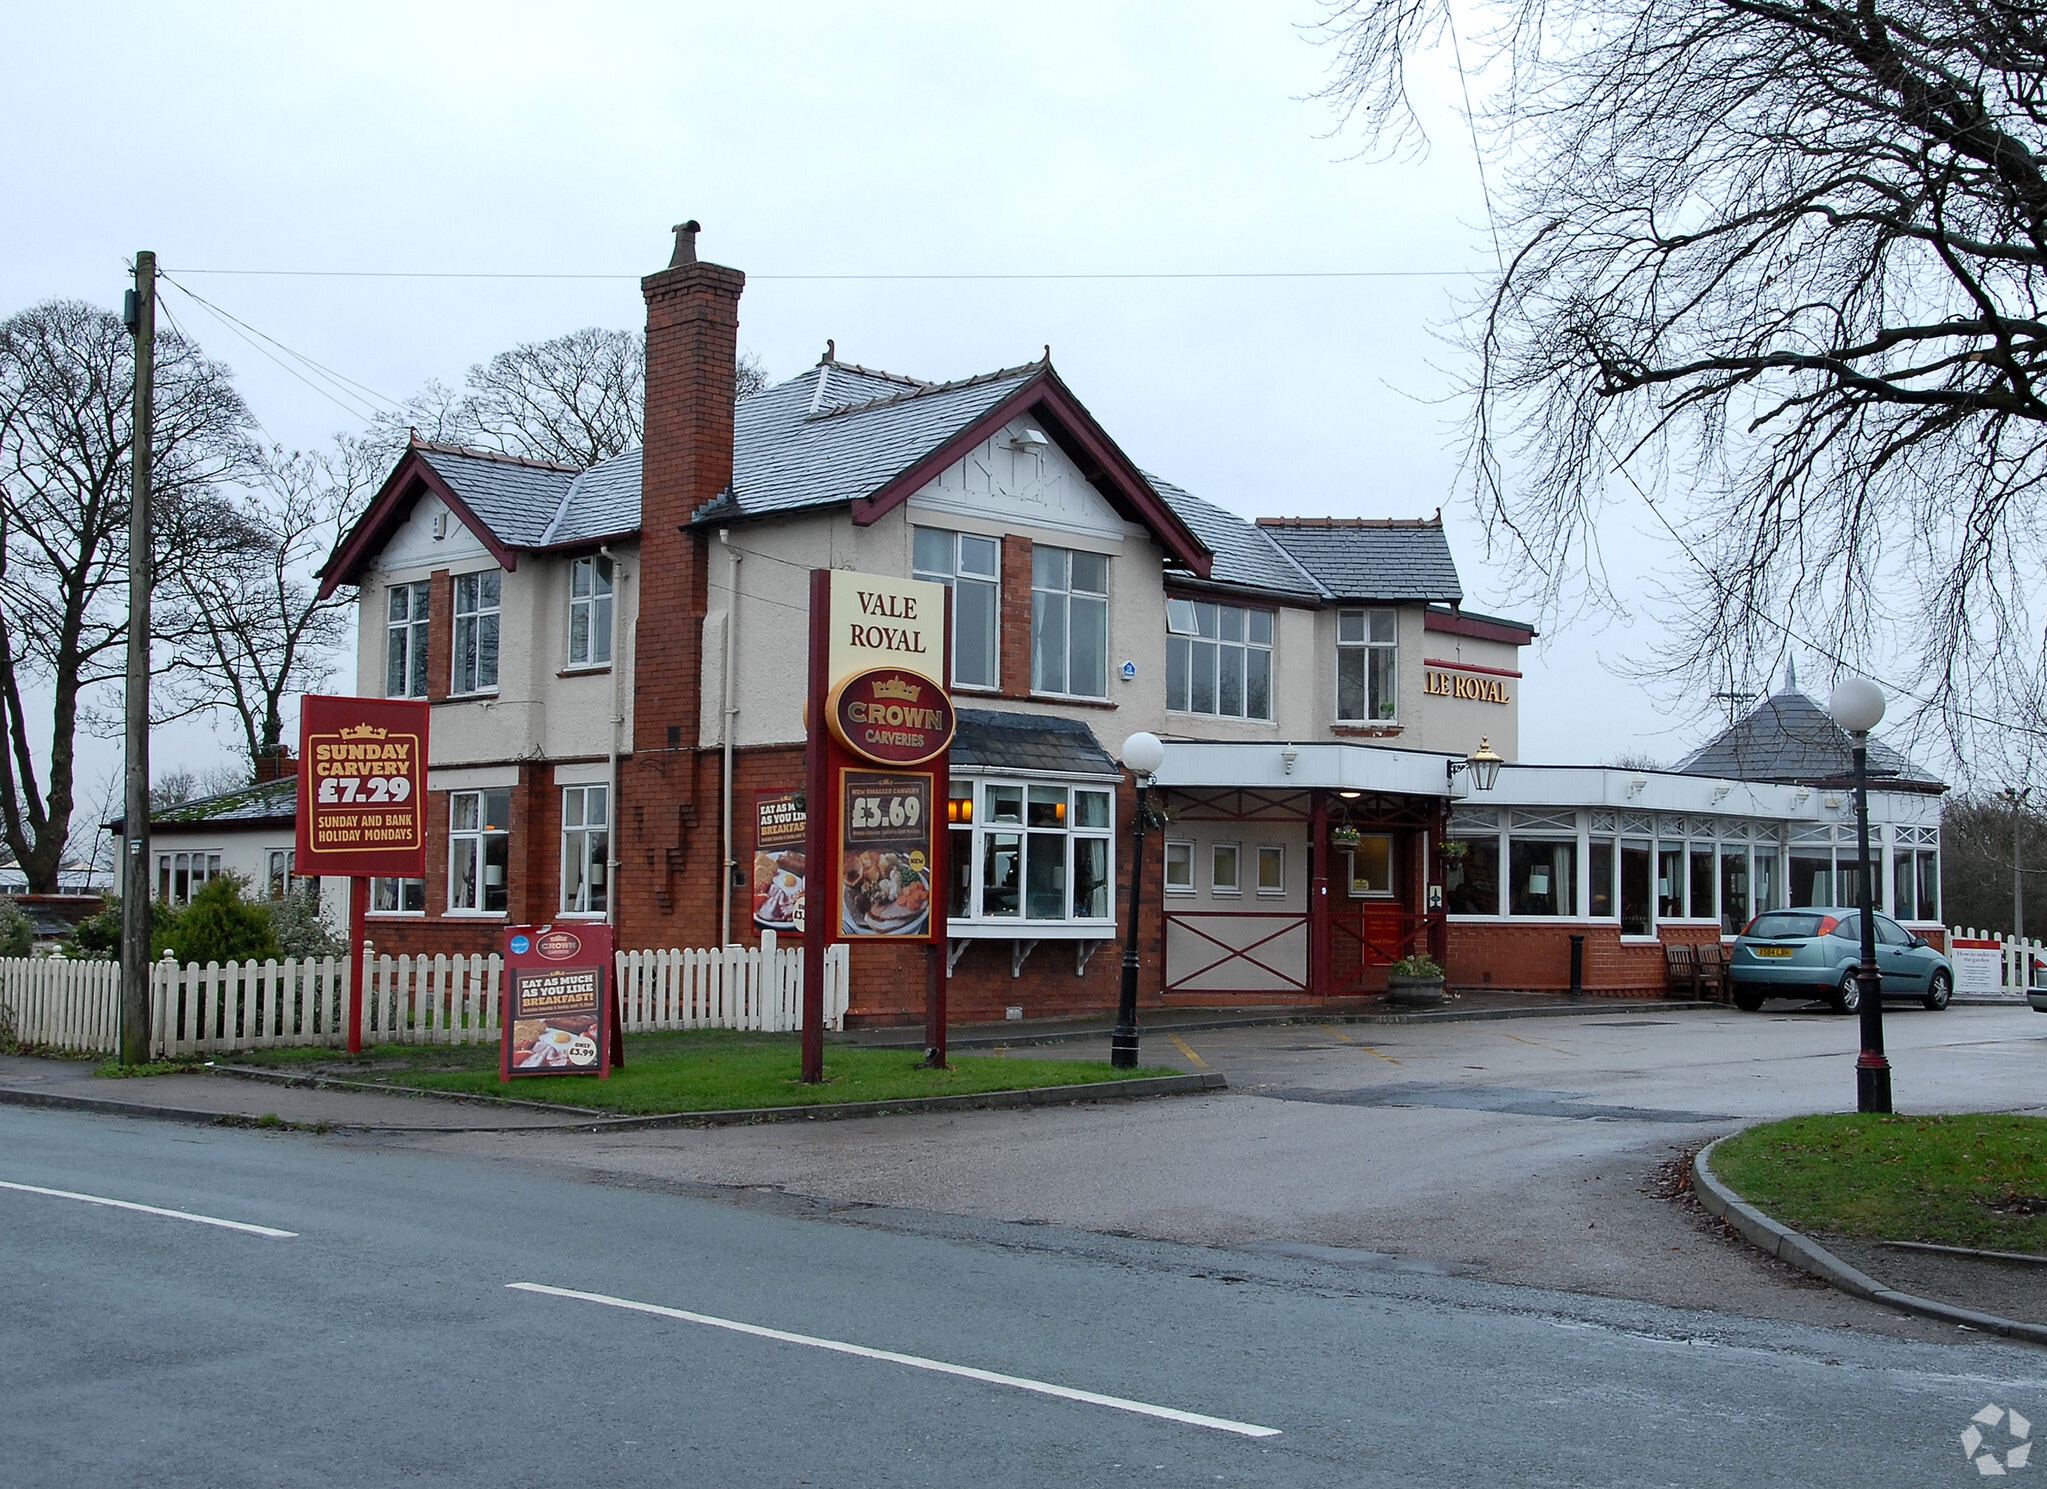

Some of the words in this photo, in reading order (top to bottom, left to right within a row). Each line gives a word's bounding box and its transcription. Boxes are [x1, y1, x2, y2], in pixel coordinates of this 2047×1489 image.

[856, 591, 918, 620] VALE
[850, 624, 926, 653] ROYAL
[1424, 672, 1451, 696] LE
[1453, 675, 1510, 705] ROYAL
[848, 701, 943, 730] CROWN
[865, 729, 924, 748] CARVERIES
[316, 744, 410, 760] SUNDAY
[317, 762, 410, 776] CARVERY
[318, 777, 411, 803] £7.29
[760, 805, 775, 815] EAT
[776, 804, 787, 813] AS
[852, 796, 920, 827] £3.69
[318, 816, 358, 828] SUNDAY
[361, 815, 382, 827] AND
[386, 815, 412, 826] BANK
[761, 814, 772, 825] AS
[774, 812, 792, 823] YOU
[793, 812, 806, 821] LIK
[319, 830, 361, 842] HOLIDAY
[365, 828, 412, 841] MONDAYS
[761, 821, 806, 835] BREAKFAS
[522, 979, 543, 988] EAT
[544, 978, 558, 986] AS
[560, 975, 593, 985] MUCH
[522, 989, 538, 998] AS
[540, 986, 565, 996] YOU
[567, 984, 593, 994] LIKE
[523, 993, 593, 1007] BREAKFAST!
[570, 1048, 594, 1056] £3.99
